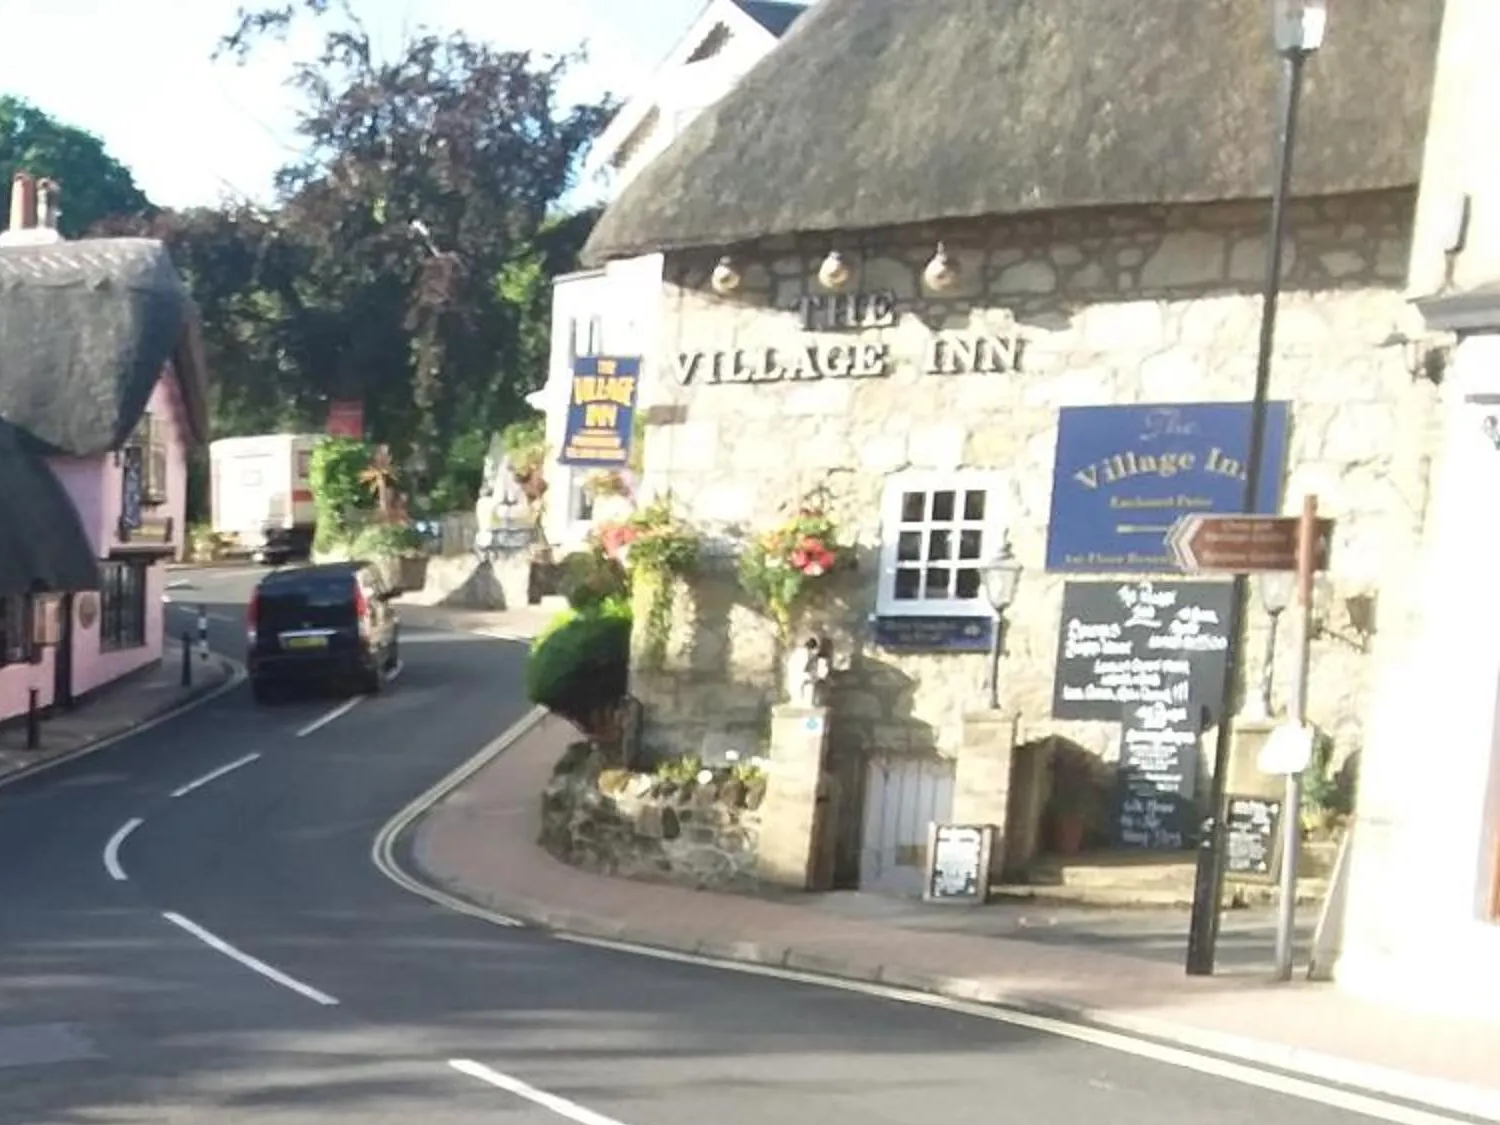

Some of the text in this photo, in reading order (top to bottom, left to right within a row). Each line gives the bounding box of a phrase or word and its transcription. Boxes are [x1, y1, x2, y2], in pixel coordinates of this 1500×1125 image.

[799, 289, 897, 330] THE
[674, 336, 1031, 385] VILLAGE INN
[1074, 447, 1247, 490] Village In
